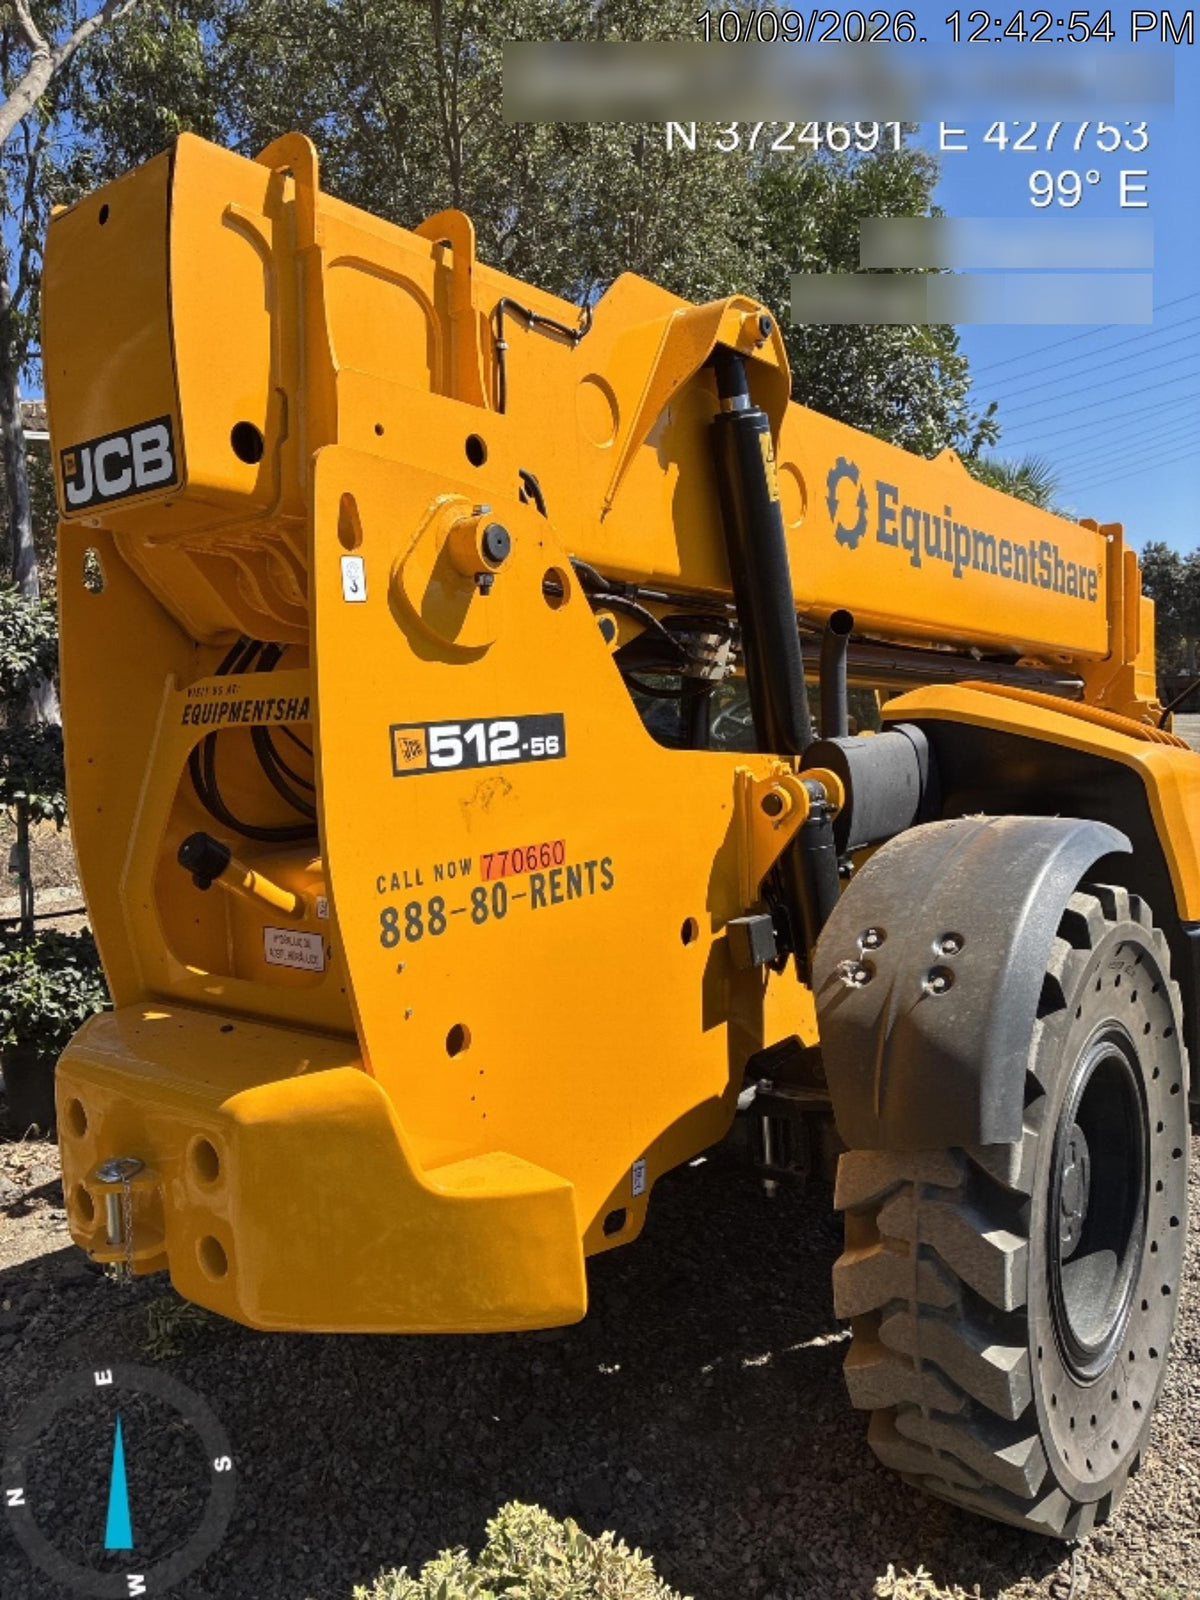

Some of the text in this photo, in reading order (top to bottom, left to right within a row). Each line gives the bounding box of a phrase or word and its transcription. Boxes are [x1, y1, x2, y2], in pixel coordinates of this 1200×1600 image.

[66, 424, 173, 504] JCB
[876, 480, 1098, 602] EquipmentShare
[376, 858, 472, 894] CALL NOW
[483, 840, 565, 880] 770660
[379, 857, 614, 949] 888-80-RENTS
